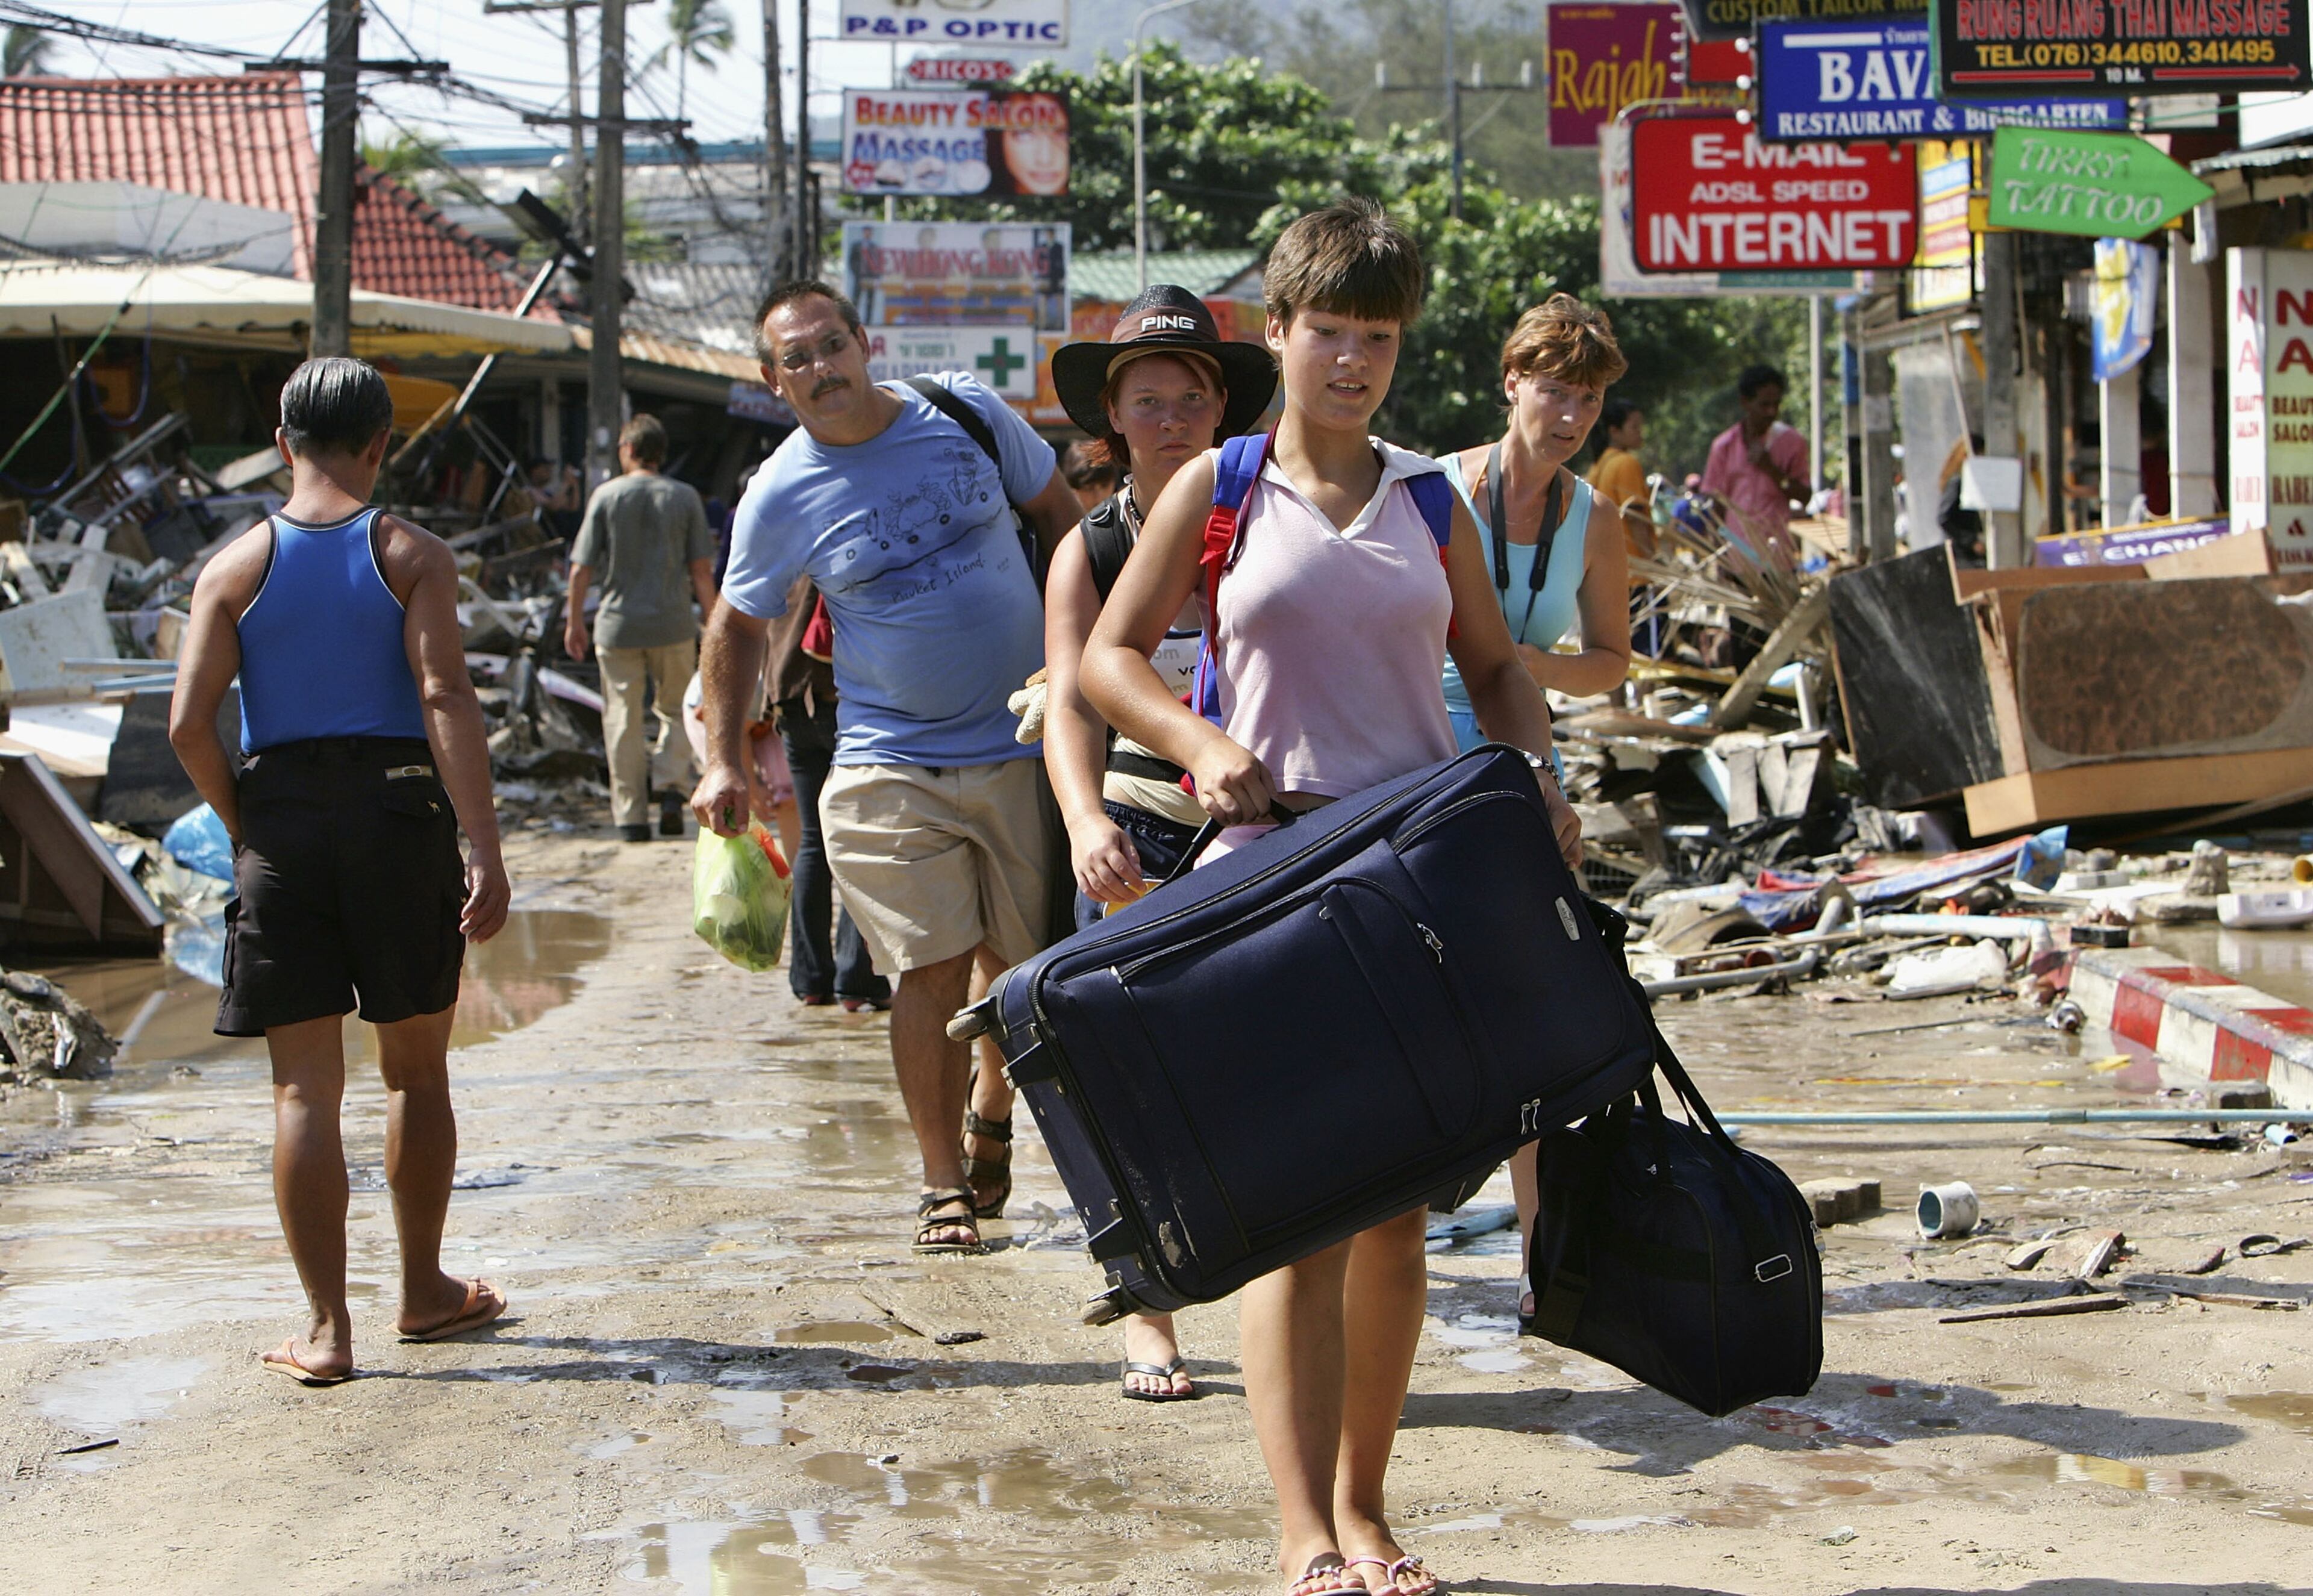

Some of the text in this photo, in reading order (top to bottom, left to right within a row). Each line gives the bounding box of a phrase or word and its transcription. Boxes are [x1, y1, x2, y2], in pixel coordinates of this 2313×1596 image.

[1707, 0, 1801, 22] CUSTOM
[2111, 0, 2167, 38] THAI
[2170, 0, 2290, 37] MASSAGE
[846, 17, 1060, 39] P&P OPTIC
[1552, 19, 1666, 125] Rajah
[855, 98, 1059, 129] BEAUTY SALON
[1777, 108, 1926, 136] RESTAURANT
[1932, 105, 1957, 131] &
[852, 132, 985, 163] MASSAGE
[1691, 132, 1866, 169] E-MAIL
[1689, 180, 1870, 204] ADSL SPEED
[2004, 179, 2164, 225] TATTOO
[1649, 210, 1911, 264] INTERNET
[1141, 314, 1196, 331] PING
